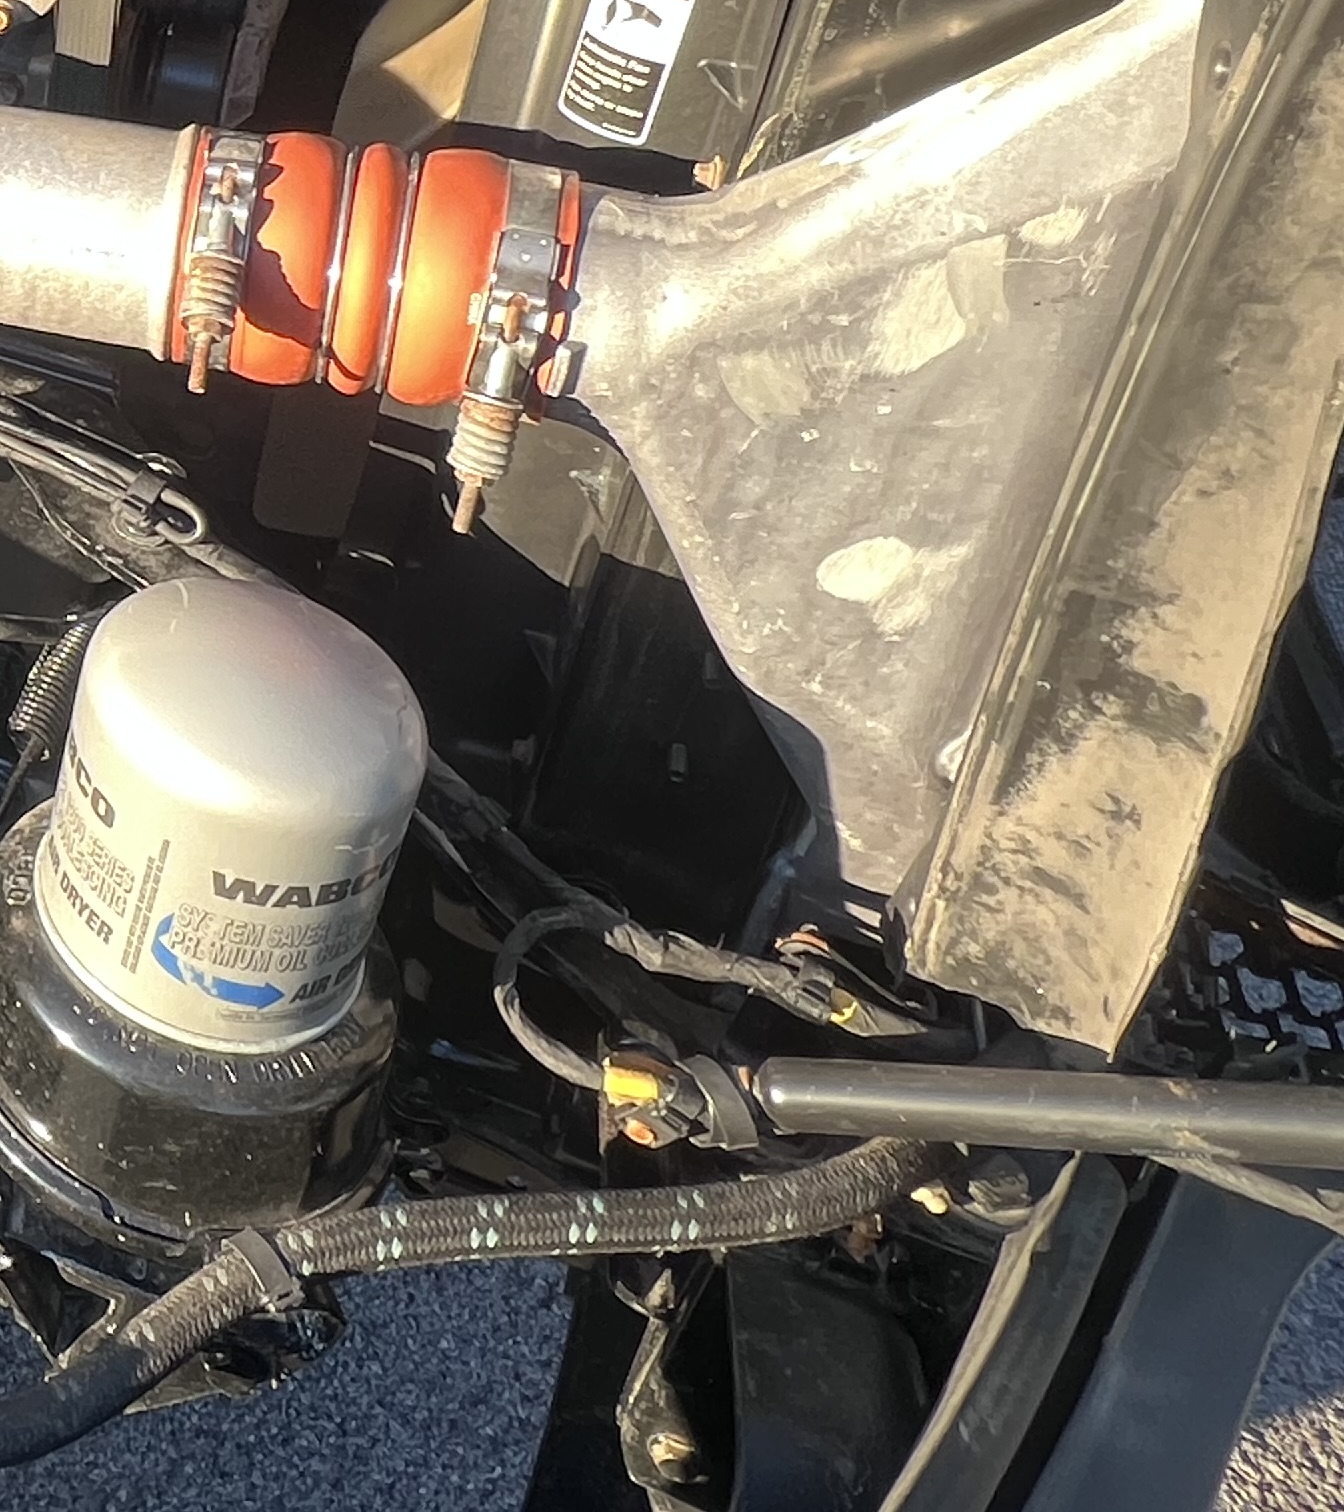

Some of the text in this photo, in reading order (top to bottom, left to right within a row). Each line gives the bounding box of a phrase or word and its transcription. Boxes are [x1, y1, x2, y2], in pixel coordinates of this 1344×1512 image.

[60, 871, 114, 945] DRYER
[275, 950, 307, 973] OIL
[289, 975, 332, 1004] AIR
